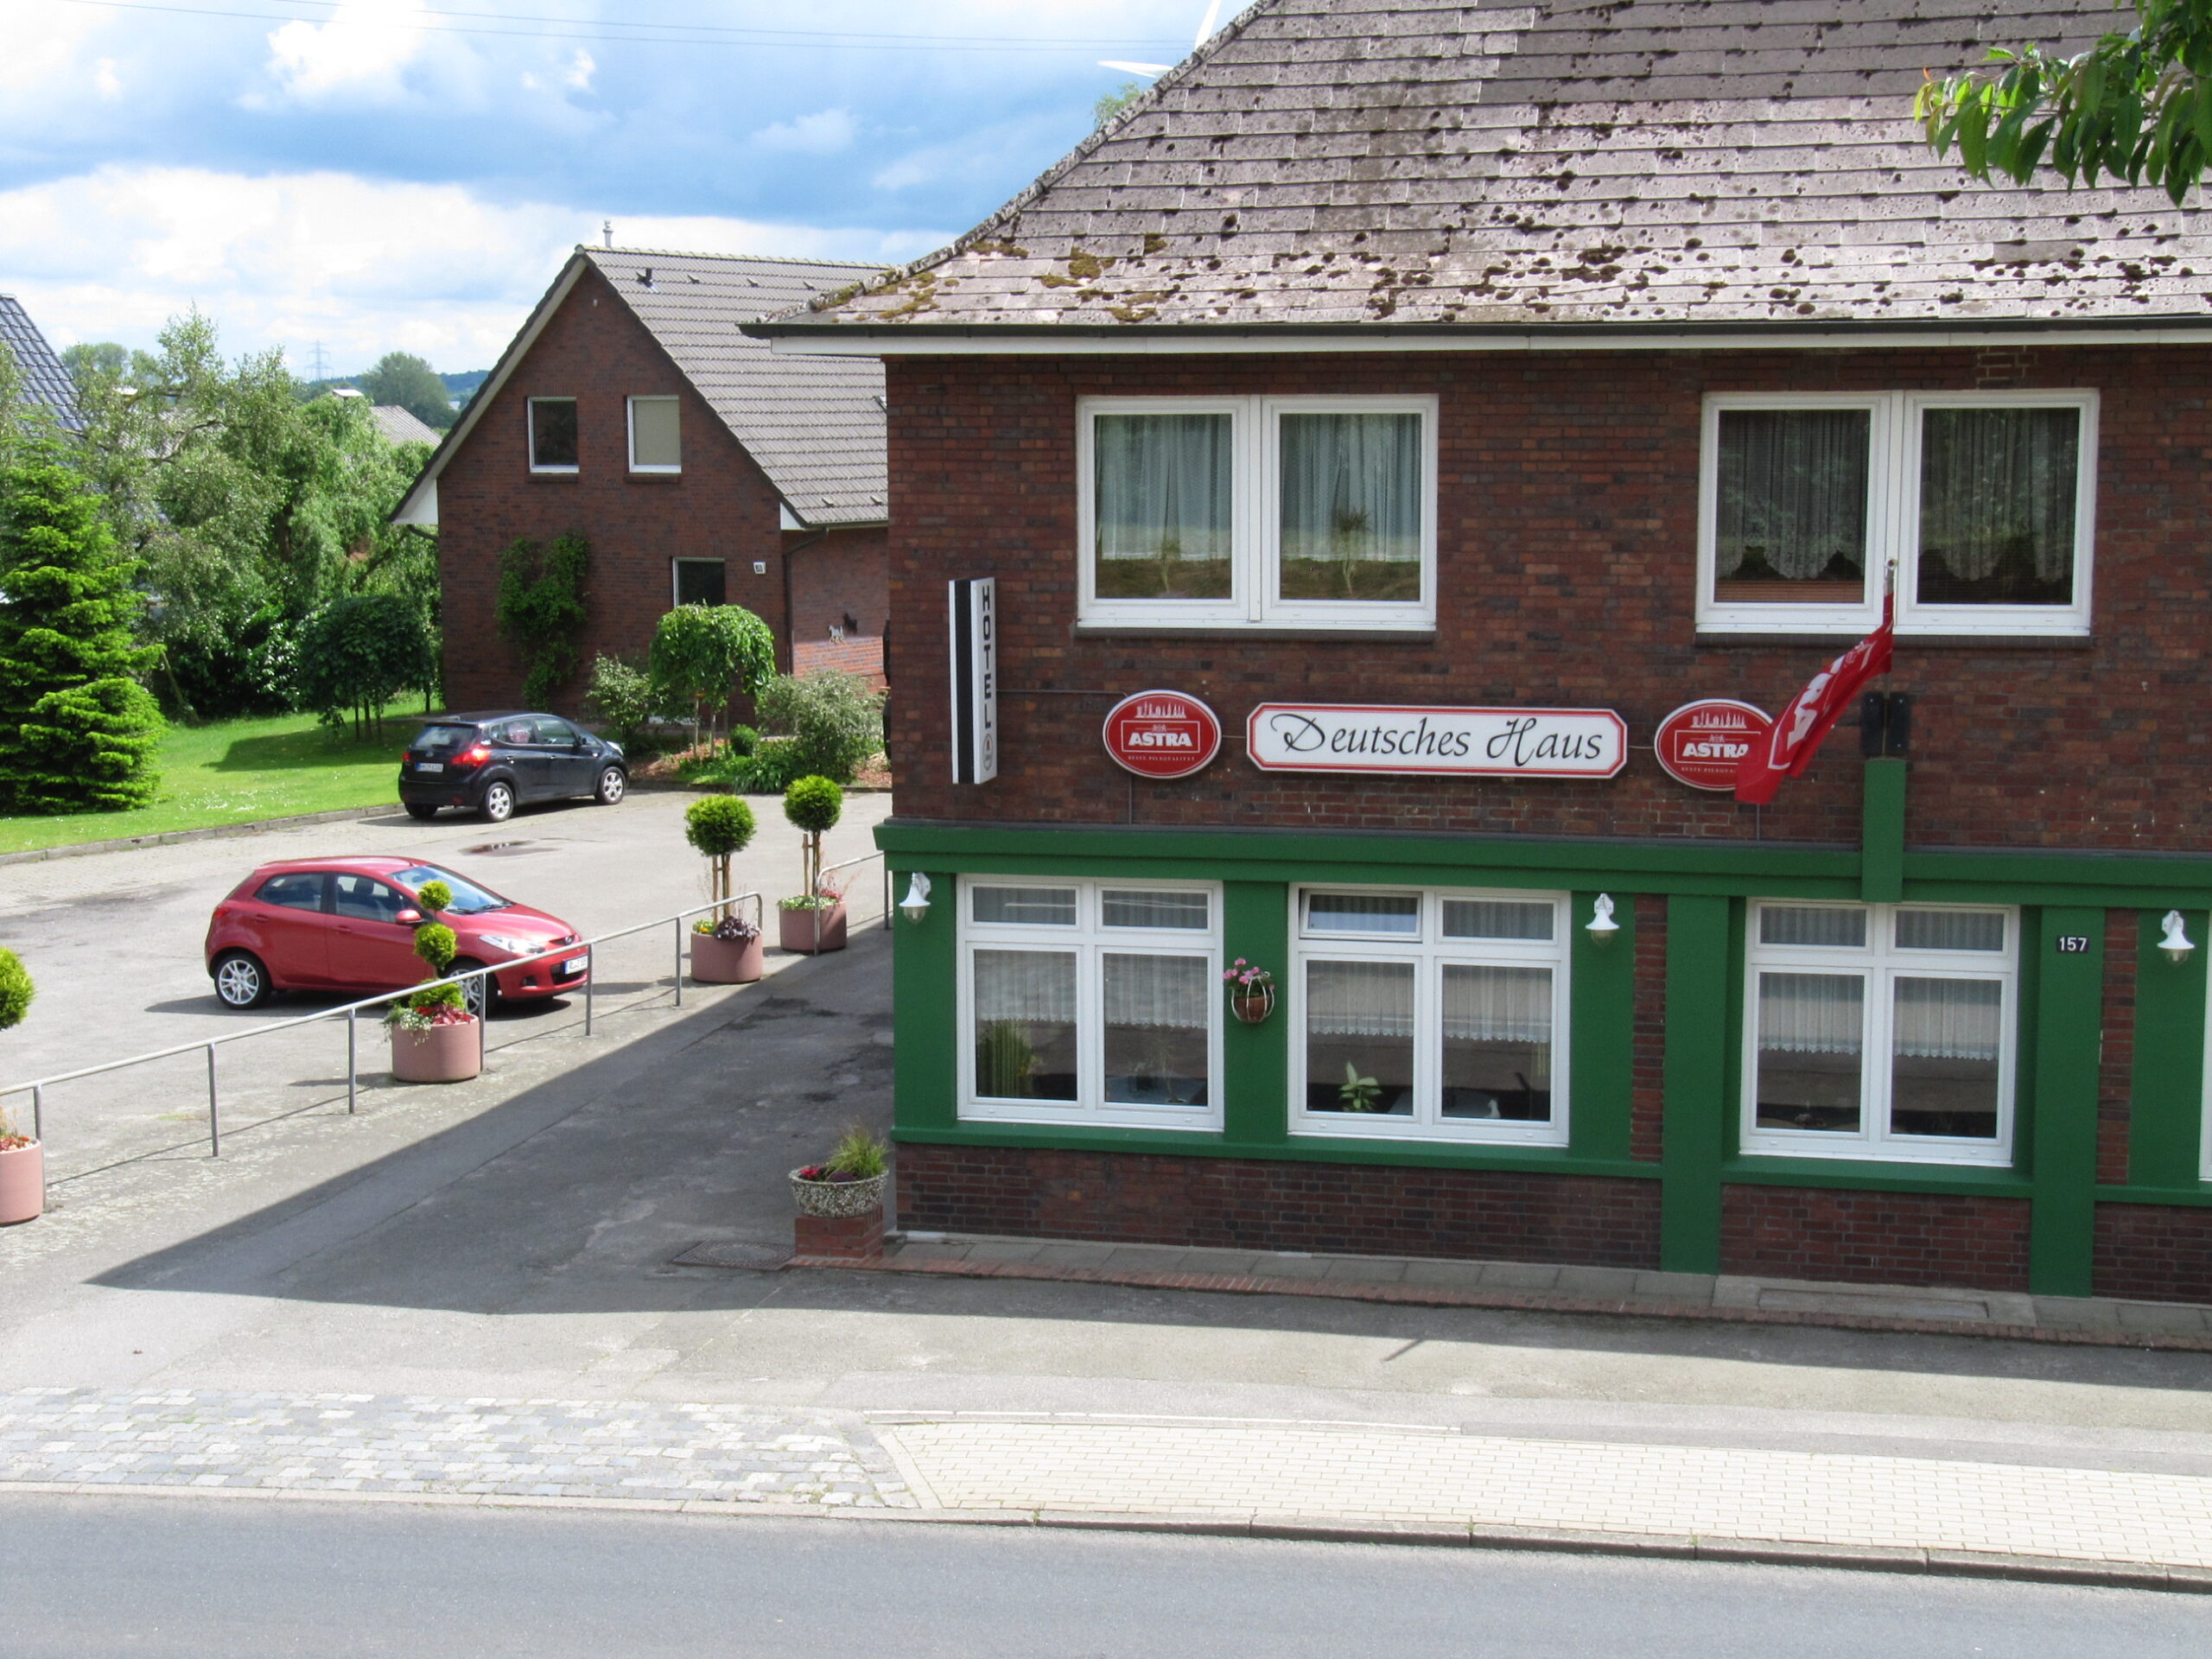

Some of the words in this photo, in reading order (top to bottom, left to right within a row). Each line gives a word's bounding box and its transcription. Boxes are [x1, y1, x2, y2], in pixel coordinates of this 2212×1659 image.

[982, 585, 992, 729] HOTEL
[1128, 732, 1192, 747] ASTRA
[1270, 713, 1471, 757] Deutsches
[1486, 717, 1602, 767] Haus
[2059, 937, 2088, 951] 157
